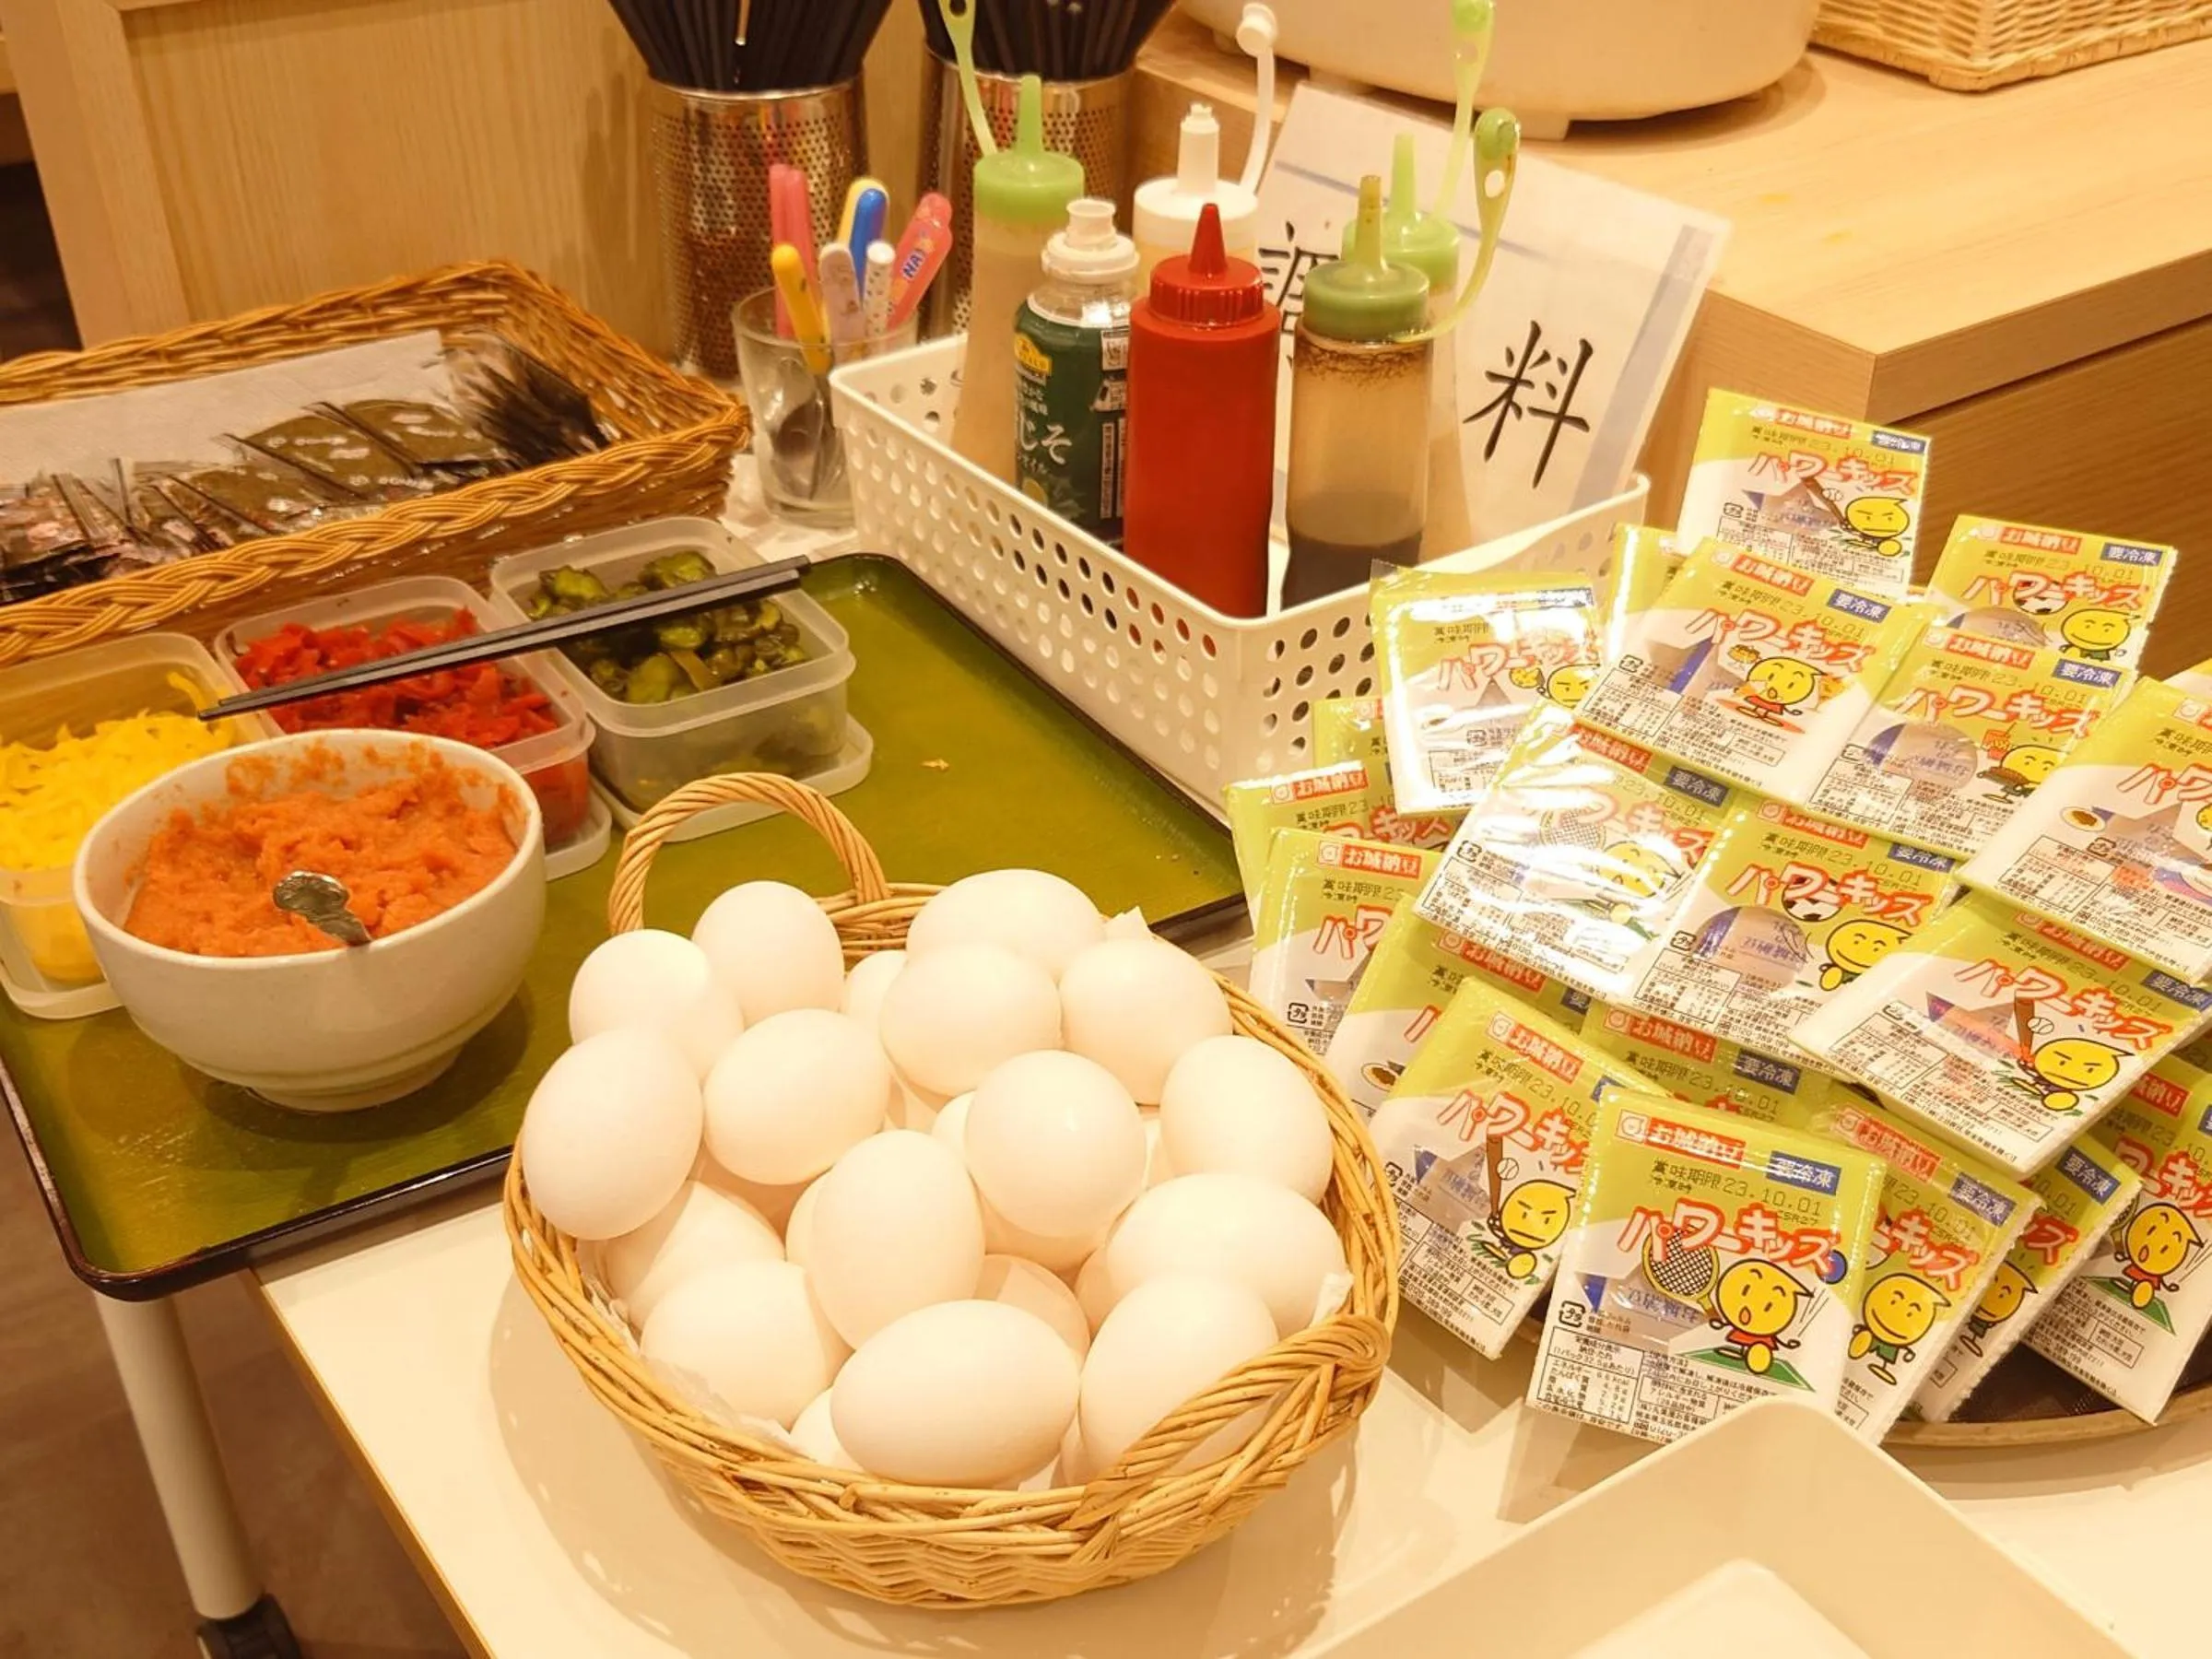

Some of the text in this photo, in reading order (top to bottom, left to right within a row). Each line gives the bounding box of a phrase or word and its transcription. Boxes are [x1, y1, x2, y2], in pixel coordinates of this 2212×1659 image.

[1462, 320, 1594, 488] 料
[1748, 451, 1919, 497] パワーキッズ
[2107, 546, 2159, 566] 要冷凍
[1835, 592, 1887, 620] 要冷凍
[1960, 571, 2150, 609] パワーキッズ
[1686, 608, 1877, 674] パワーキッズ
[2062, 662, 2116, 686] 要冷凍
[1893, 684, 2101, 738] パワーキッズ
[1674, 770, 1723, 804] 要冷凍
[1726, 861, 1935, 927] パワーキッズ
[1954, 959, 2174, 1050] パワーキッズ
[1739, 1054, 1794, 1088] 要冷凍
[2063, 1153, 2112, 1198] 要冷凍
[1959, 1180, 2007, 1223] 要冷凍
[1617, 1197, 1841, 1277] パワーキッズ
